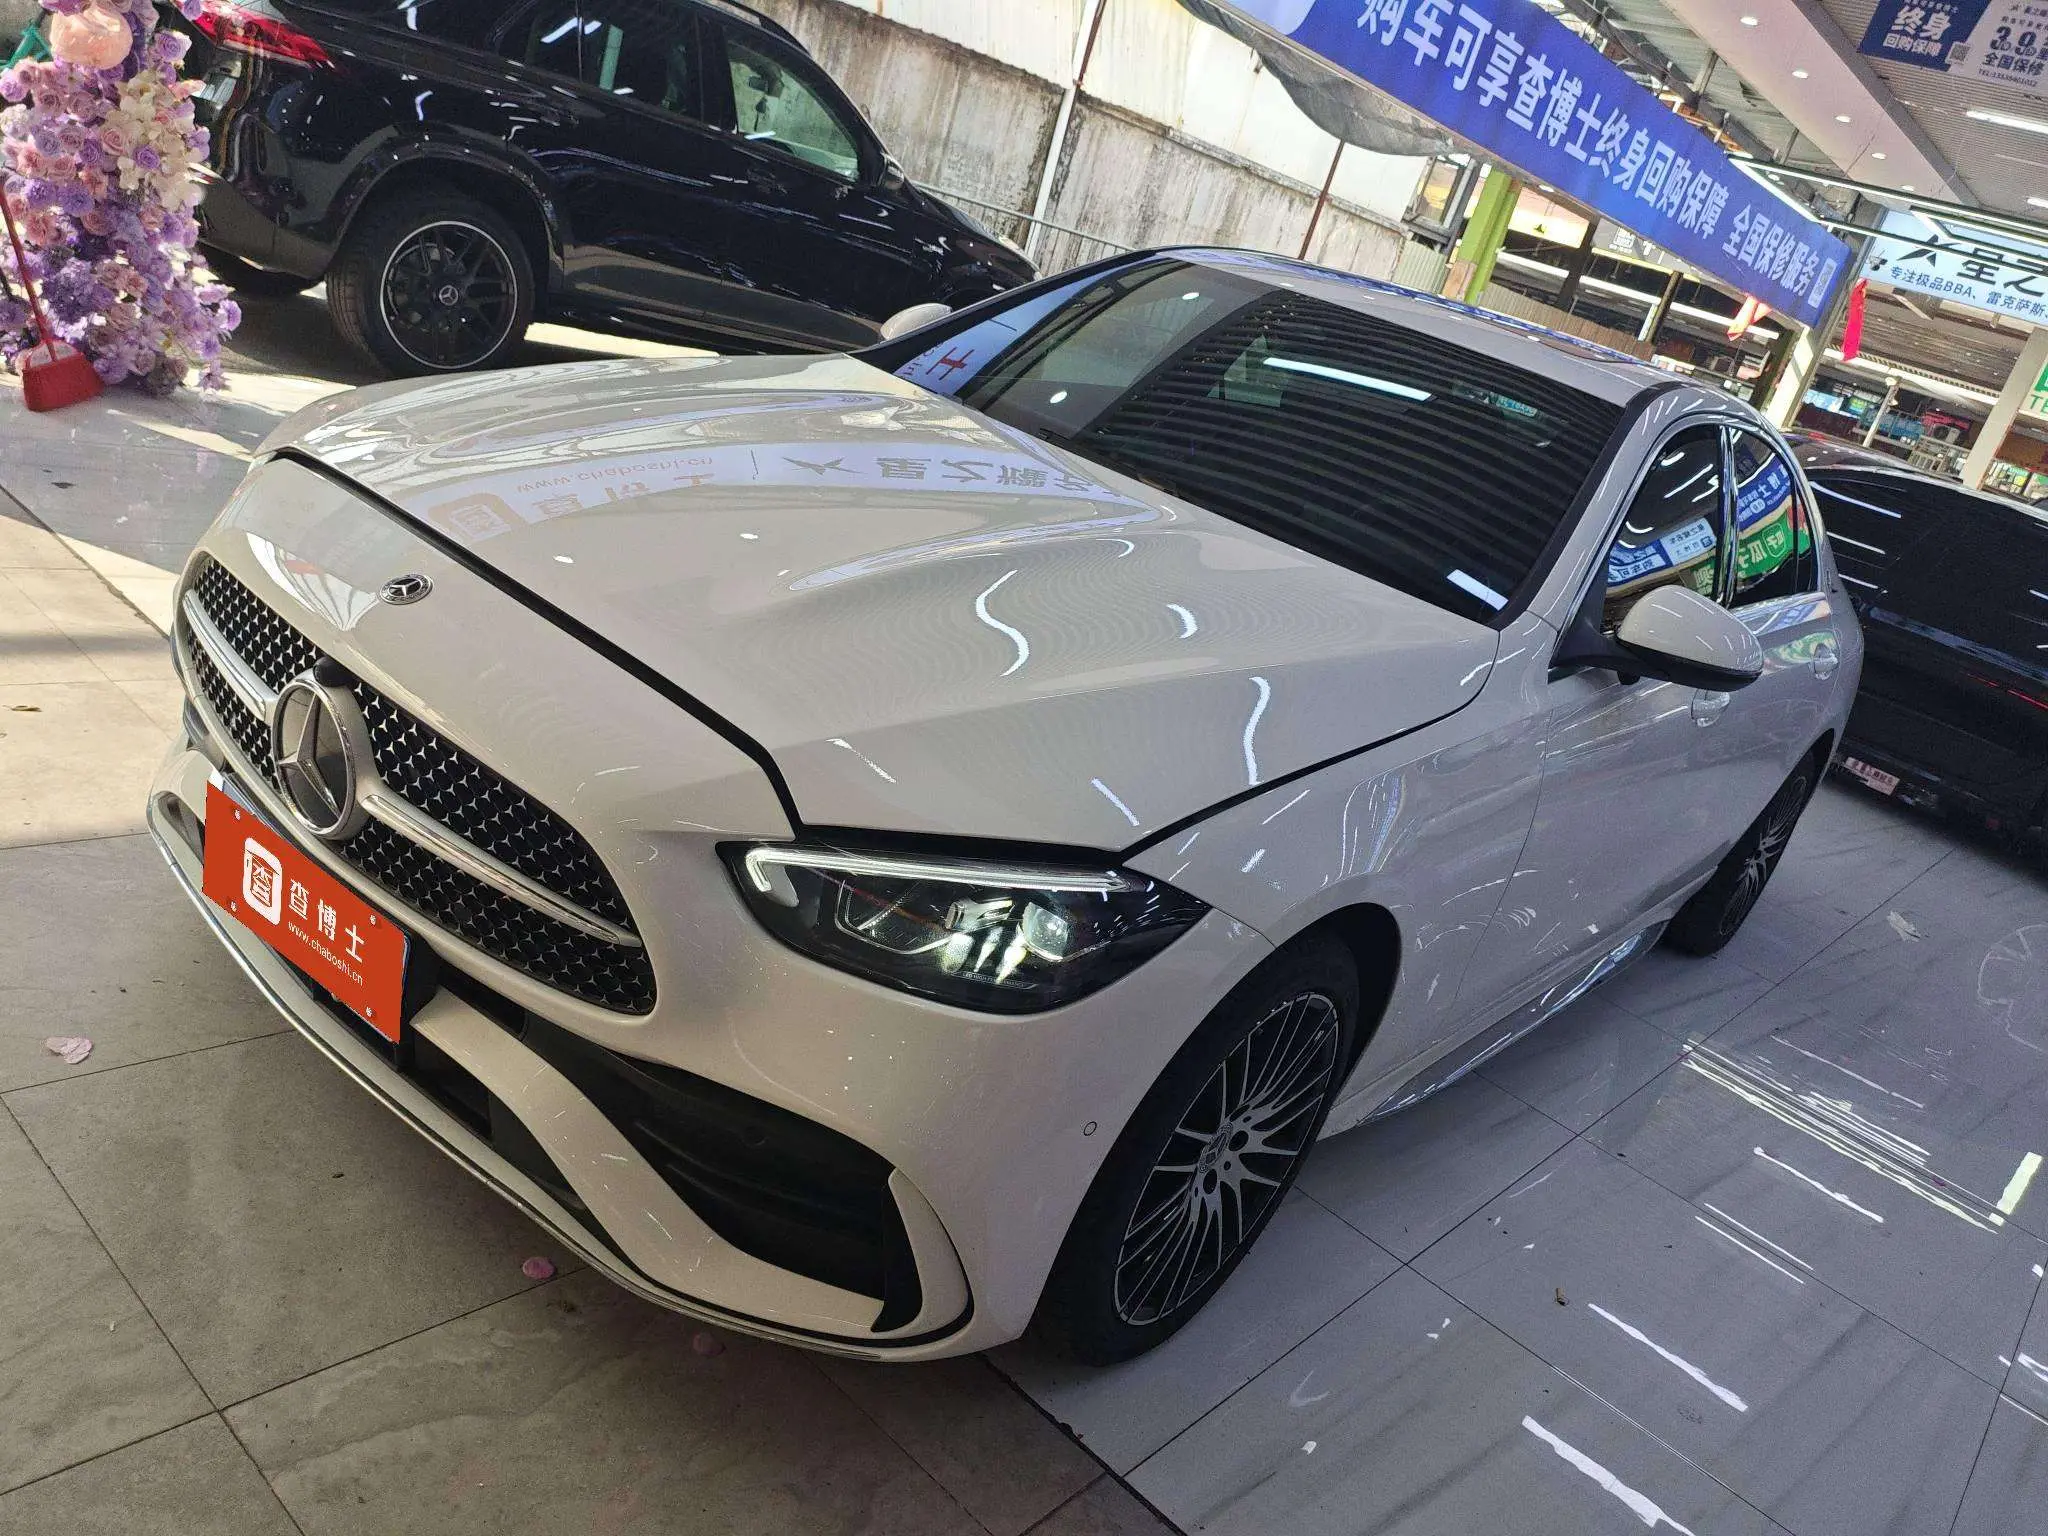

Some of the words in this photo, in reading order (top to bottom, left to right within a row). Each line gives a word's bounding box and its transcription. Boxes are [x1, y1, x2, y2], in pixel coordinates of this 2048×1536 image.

[1882, 33, 1942, 57] 回购保障
[1891, 5, 1951, 41] 终身
[1982, 51, 2046, 77] 全国保修
[1722, 203, 1821, 298] 全国保修服务
[288, 878, 366, 963] 查博士
[287, 920, 364, 987] www.chaboshi.cn
